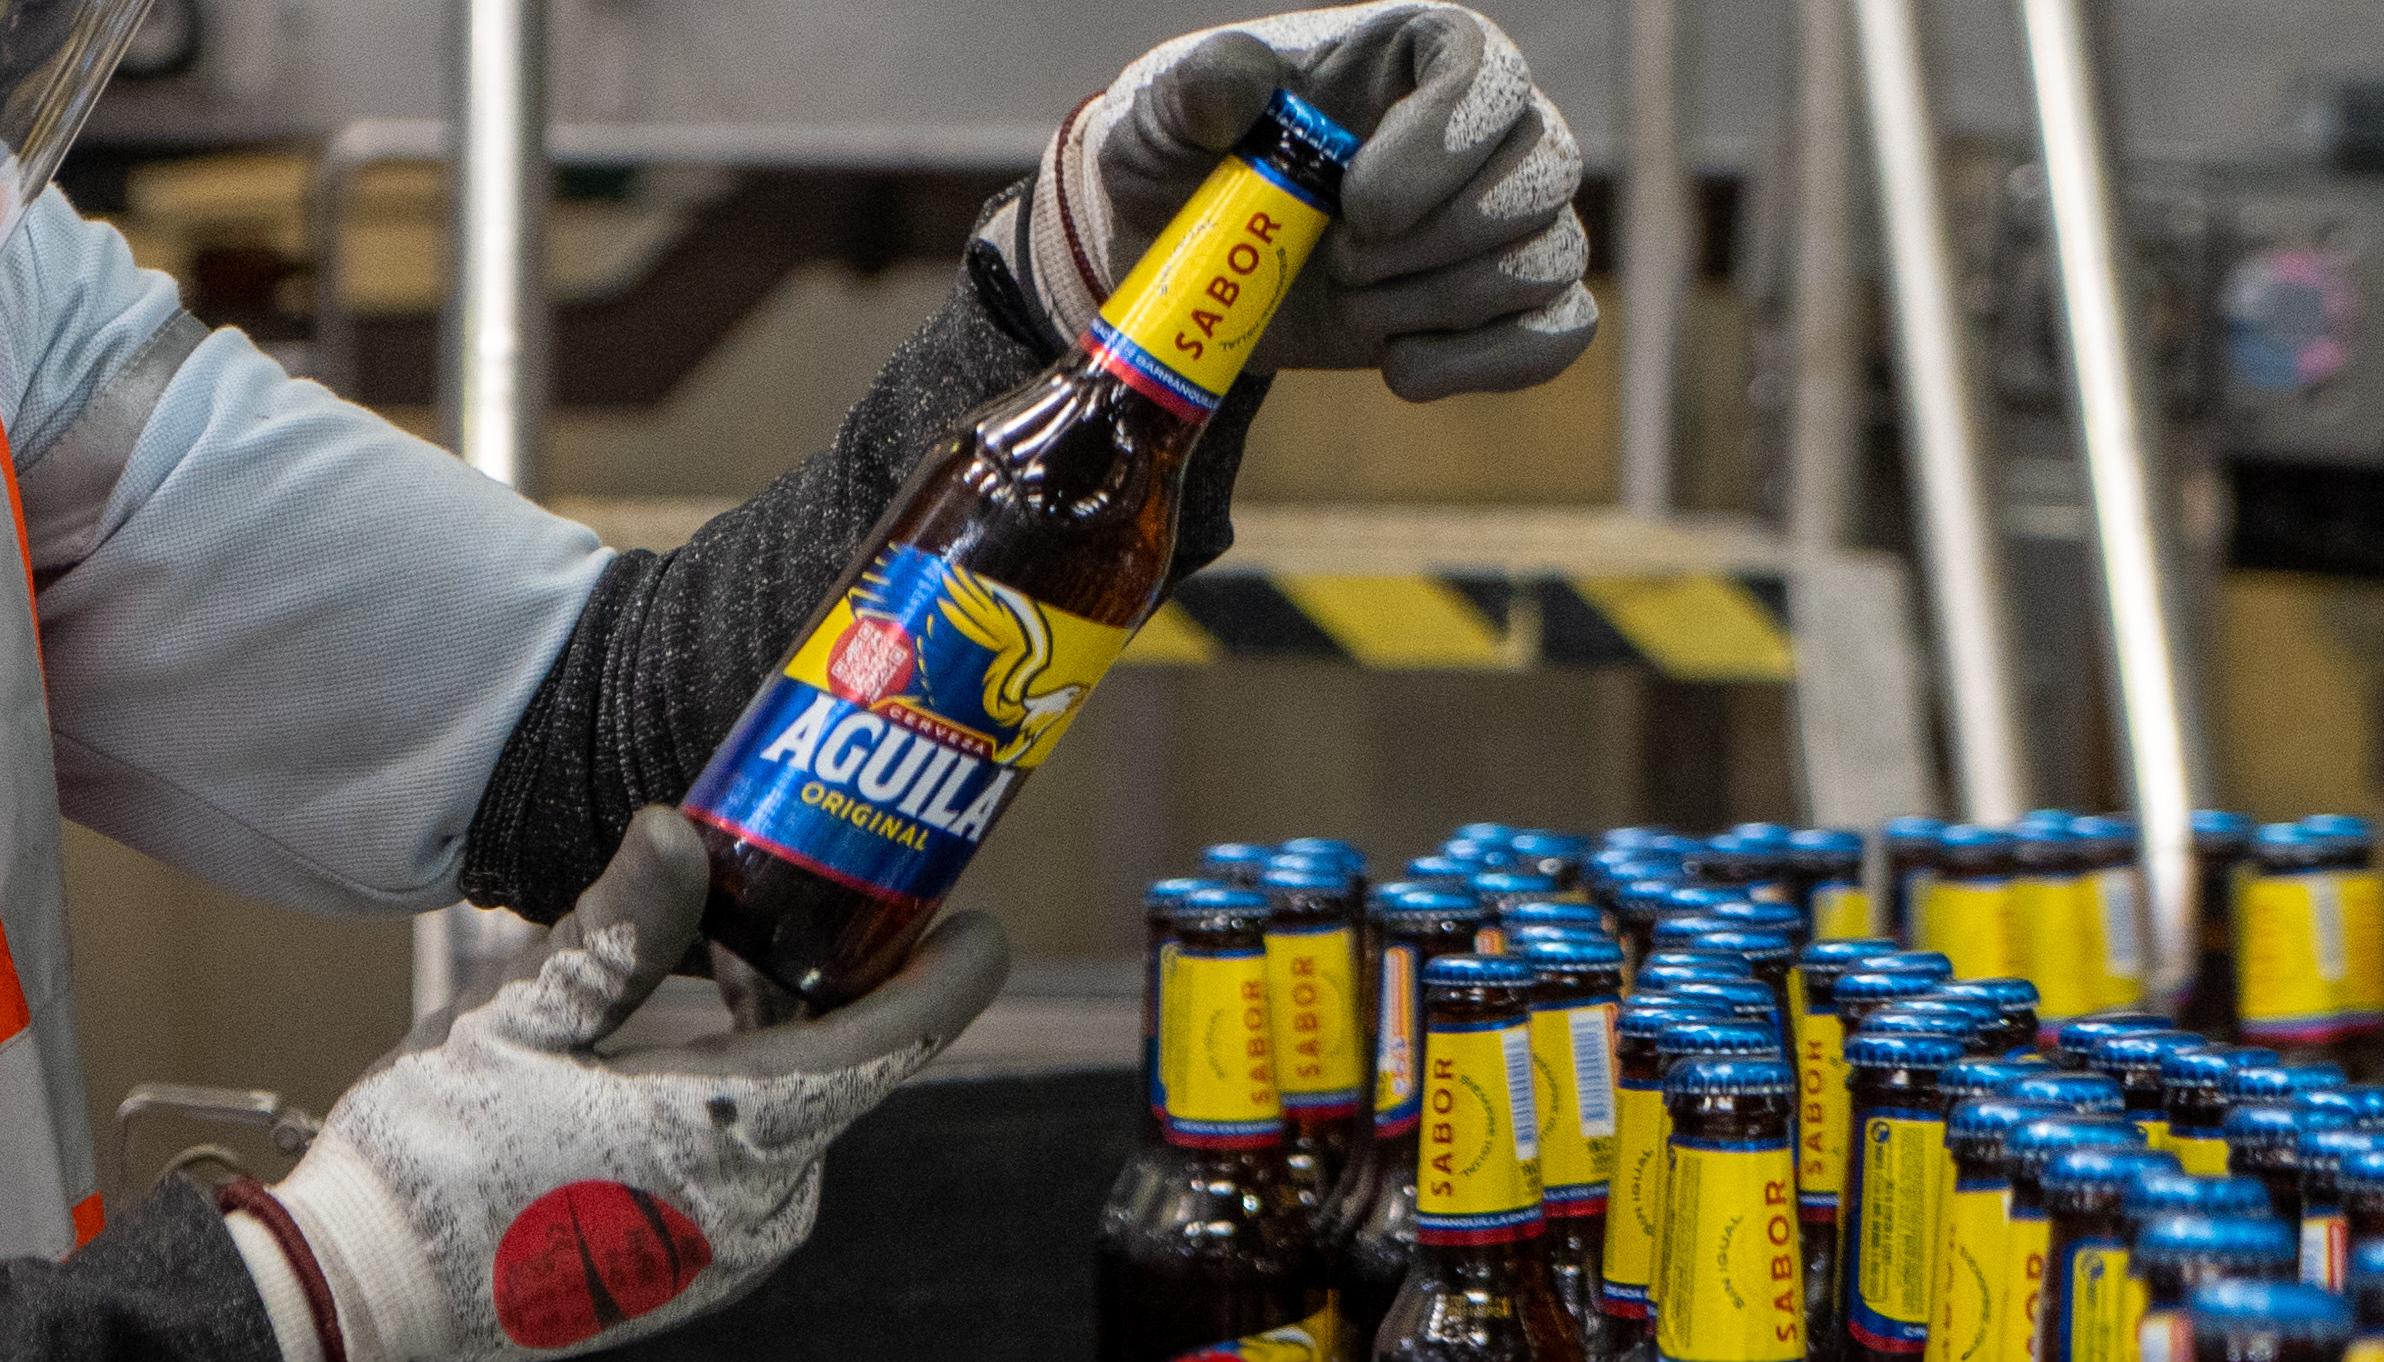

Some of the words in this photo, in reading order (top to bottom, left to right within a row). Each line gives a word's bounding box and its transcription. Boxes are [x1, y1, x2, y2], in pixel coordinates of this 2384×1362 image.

[1174, 211, 1282, 361] SABOR
[759, 691, 1016, 843] AGUILA
[889, 704, 985, 755] CERVEZA
[801, 780, 929, 851] ORIGINAL
[1240, 980, 1274, 1104] SABOR
[1291, 956, 1321, 1079] SABOR
[1431, 1057, 1455, 1198] SABOR
[1805, 1039, 1824, 1175] SABOR
[1716, 1214, 1744, 1272] IGUAL
[1764, 1179, 1800, 1343] SABOR
